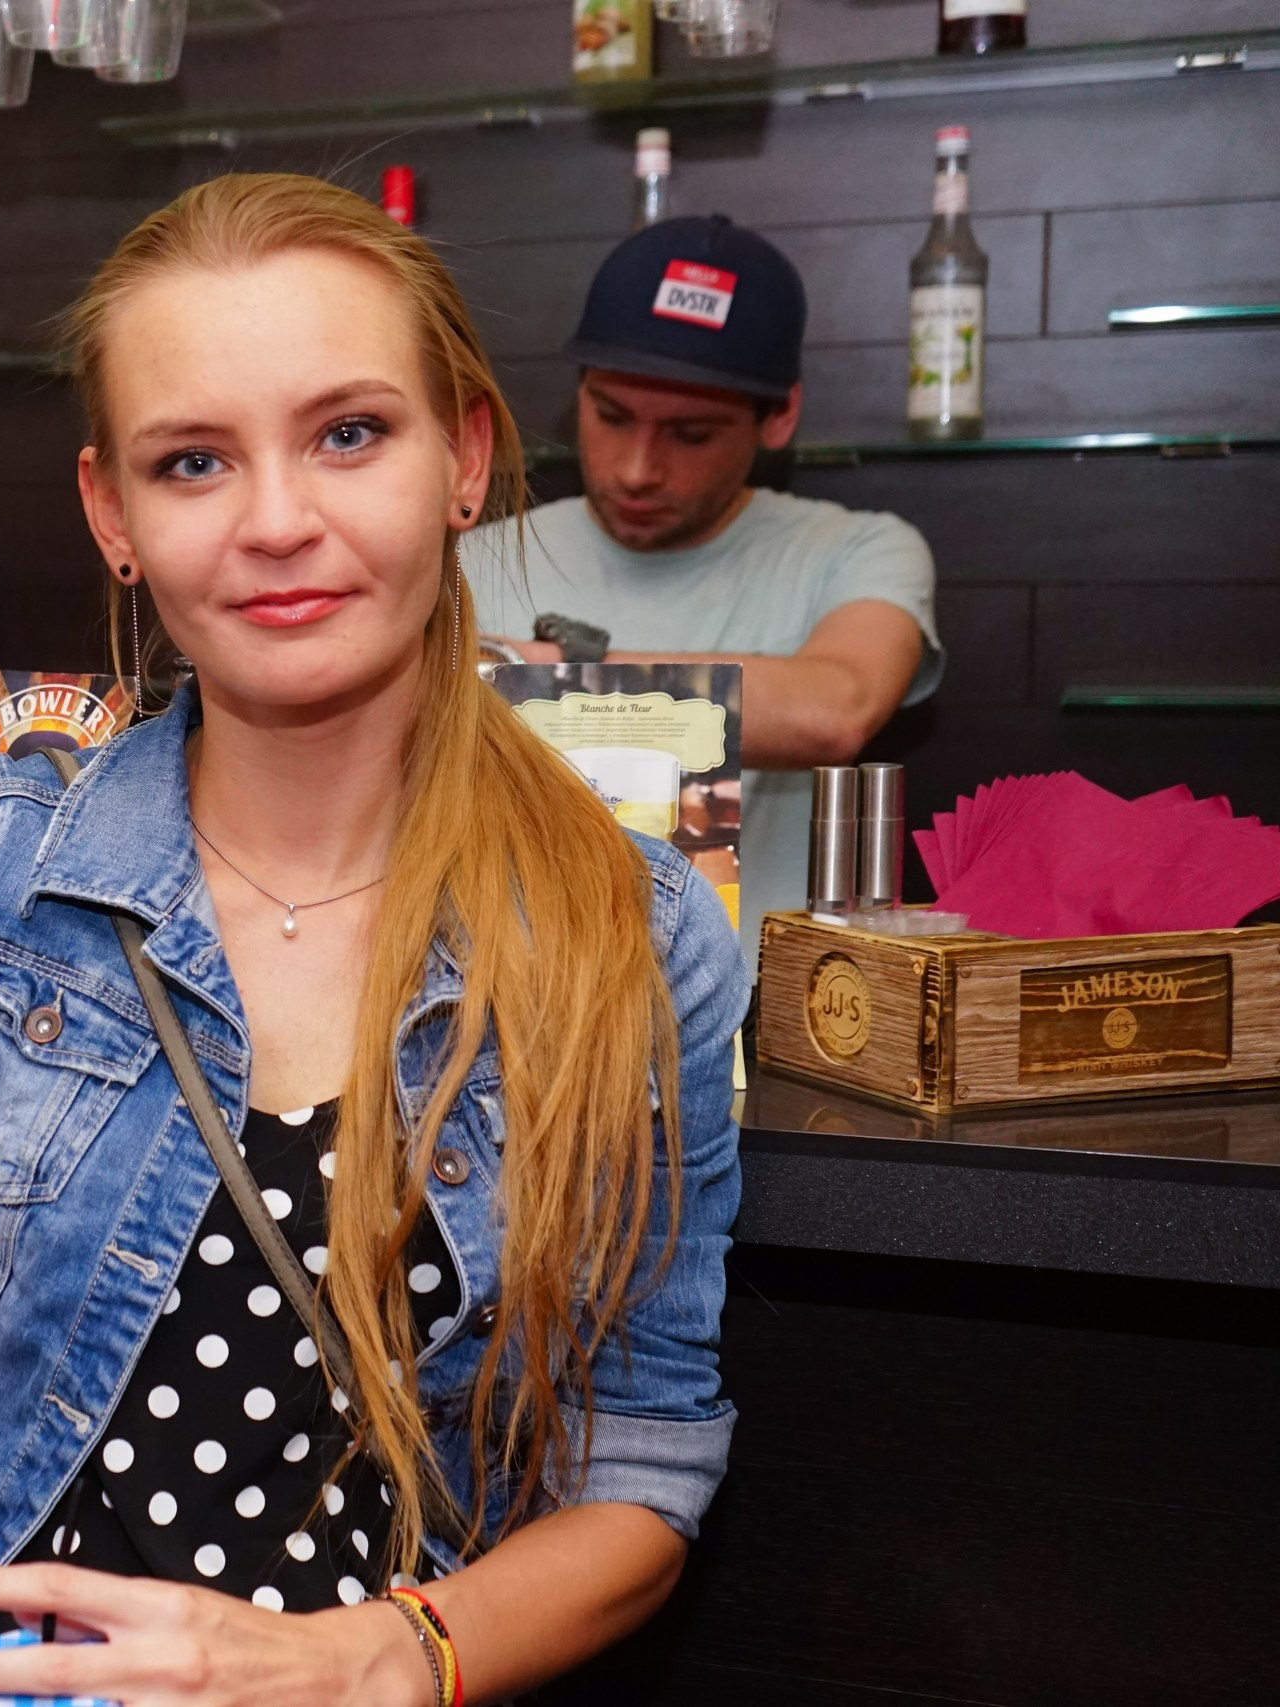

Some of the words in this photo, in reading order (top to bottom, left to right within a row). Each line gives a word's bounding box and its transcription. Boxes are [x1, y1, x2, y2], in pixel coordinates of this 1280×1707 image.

[0, 690, 105, 734] BOWLER
[580, 703, 614, 713] Blanche
[616, 703, 627, 713] de
[629, 704, 653, 713] Fleur
[1056, 970, 1187, 1013] JAMESON
[1073, 1062, 1106, 1072] IRISH
[1110, 1058, 1163, 1069] WHISKEY
